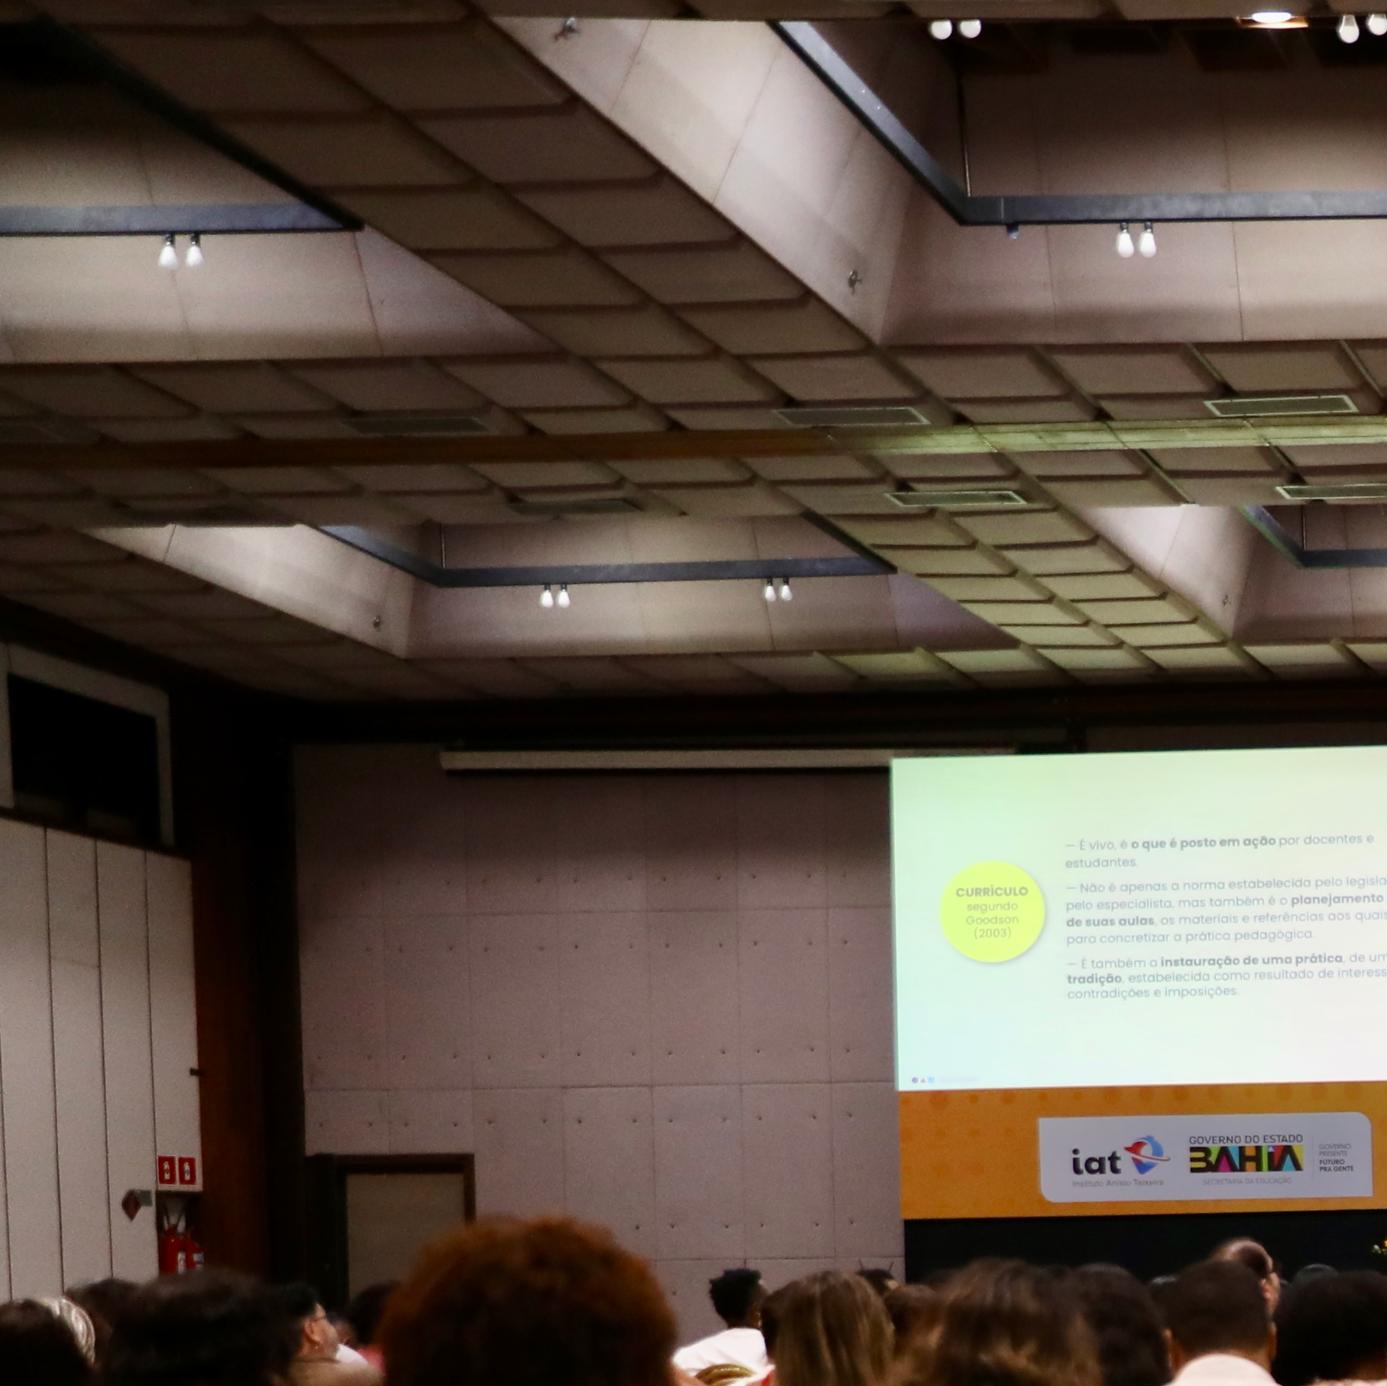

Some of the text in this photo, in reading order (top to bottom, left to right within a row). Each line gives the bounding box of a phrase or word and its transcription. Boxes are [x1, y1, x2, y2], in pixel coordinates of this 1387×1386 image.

[1142, 840, 1166, 852] que
[1180, 838, 1217, 851] posto
[1219, 839, 1240, 847] em
[1279, 837, 1300, 849] por
[1304, 834, 1362, 845] docentes
[956, 884, 1029, 897] CURRÍCULO
[967, 901, 1018, 913] segundo
[1066, 900, 1093, 914] pelo
[1178, 899, 1206, 908] mas
[1291, 893, 1384, 907] planejamento
[965, 916, 1019, 925] Goodson
[974, 926, 1011, 940] (2003)
[1189, 1134, 1303, 1145] GOVERNO DO ESTADO
[1072, 1148, 1121, 1175] iat
[1189, 1145, 1304, 1172] BAHIA
